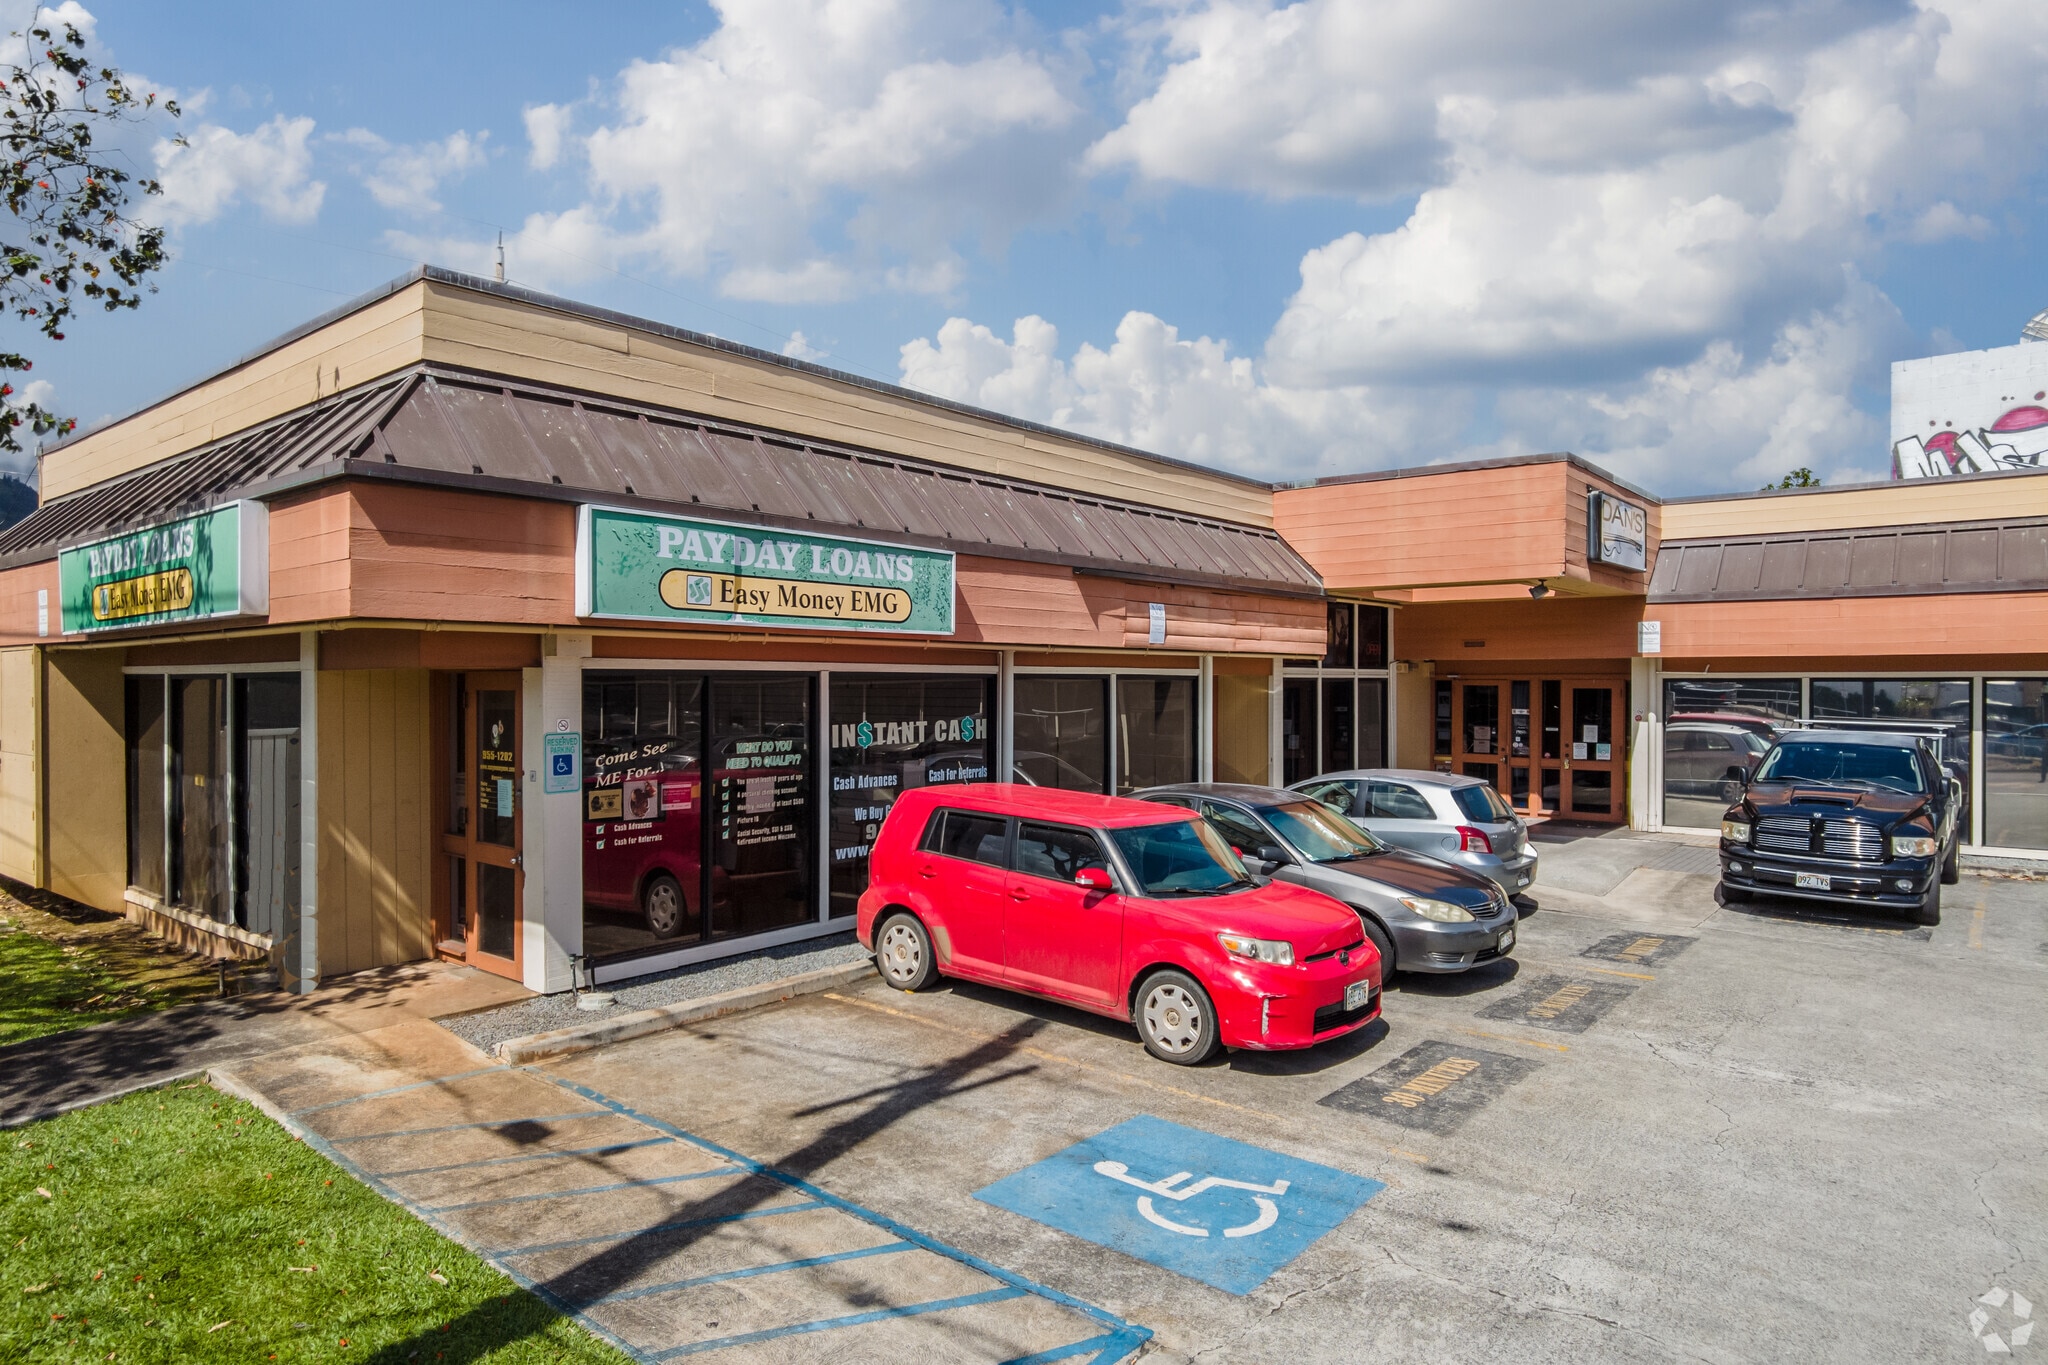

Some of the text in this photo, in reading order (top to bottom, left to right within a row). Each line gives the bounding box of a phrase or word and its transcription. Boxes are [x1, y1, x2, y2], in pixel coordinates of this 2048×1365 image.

[1602, 499, 1643, 534] DAN'S
[90, 523, 193, 578] PAYDAY LOANS
[656, 525, 914, 582] PAYDAY LOANS
[110, 574, 185, 612] Easy Money EMG
[720, 578, 898, 616] Easy Money EMG
[547, 737, 578, 746] RESERVED
[550, 746, 575, 754] PARKING
[736, 740, 792, 754] WHAT DO YOU
[595, 743, 668, 768] Come See
[726, 754, 801, 770] NEED TO QUALIFY?
[595, 771, 622, 788] ME
[929, 769, 945, 782] Cash
[958, 765, 987, 779] Referrals
[833, 774, 898, 791] Cash Advances
[854, 807, 867, 821] We
[869, 806, 884, 821] Buy
[614, 822, 652, 832] Cash Advances
[614, 838, 627, 846] Cash
[638, 834, 662, 843] Referrals
[1400, 1056, 1481, 1096] MINUTES
